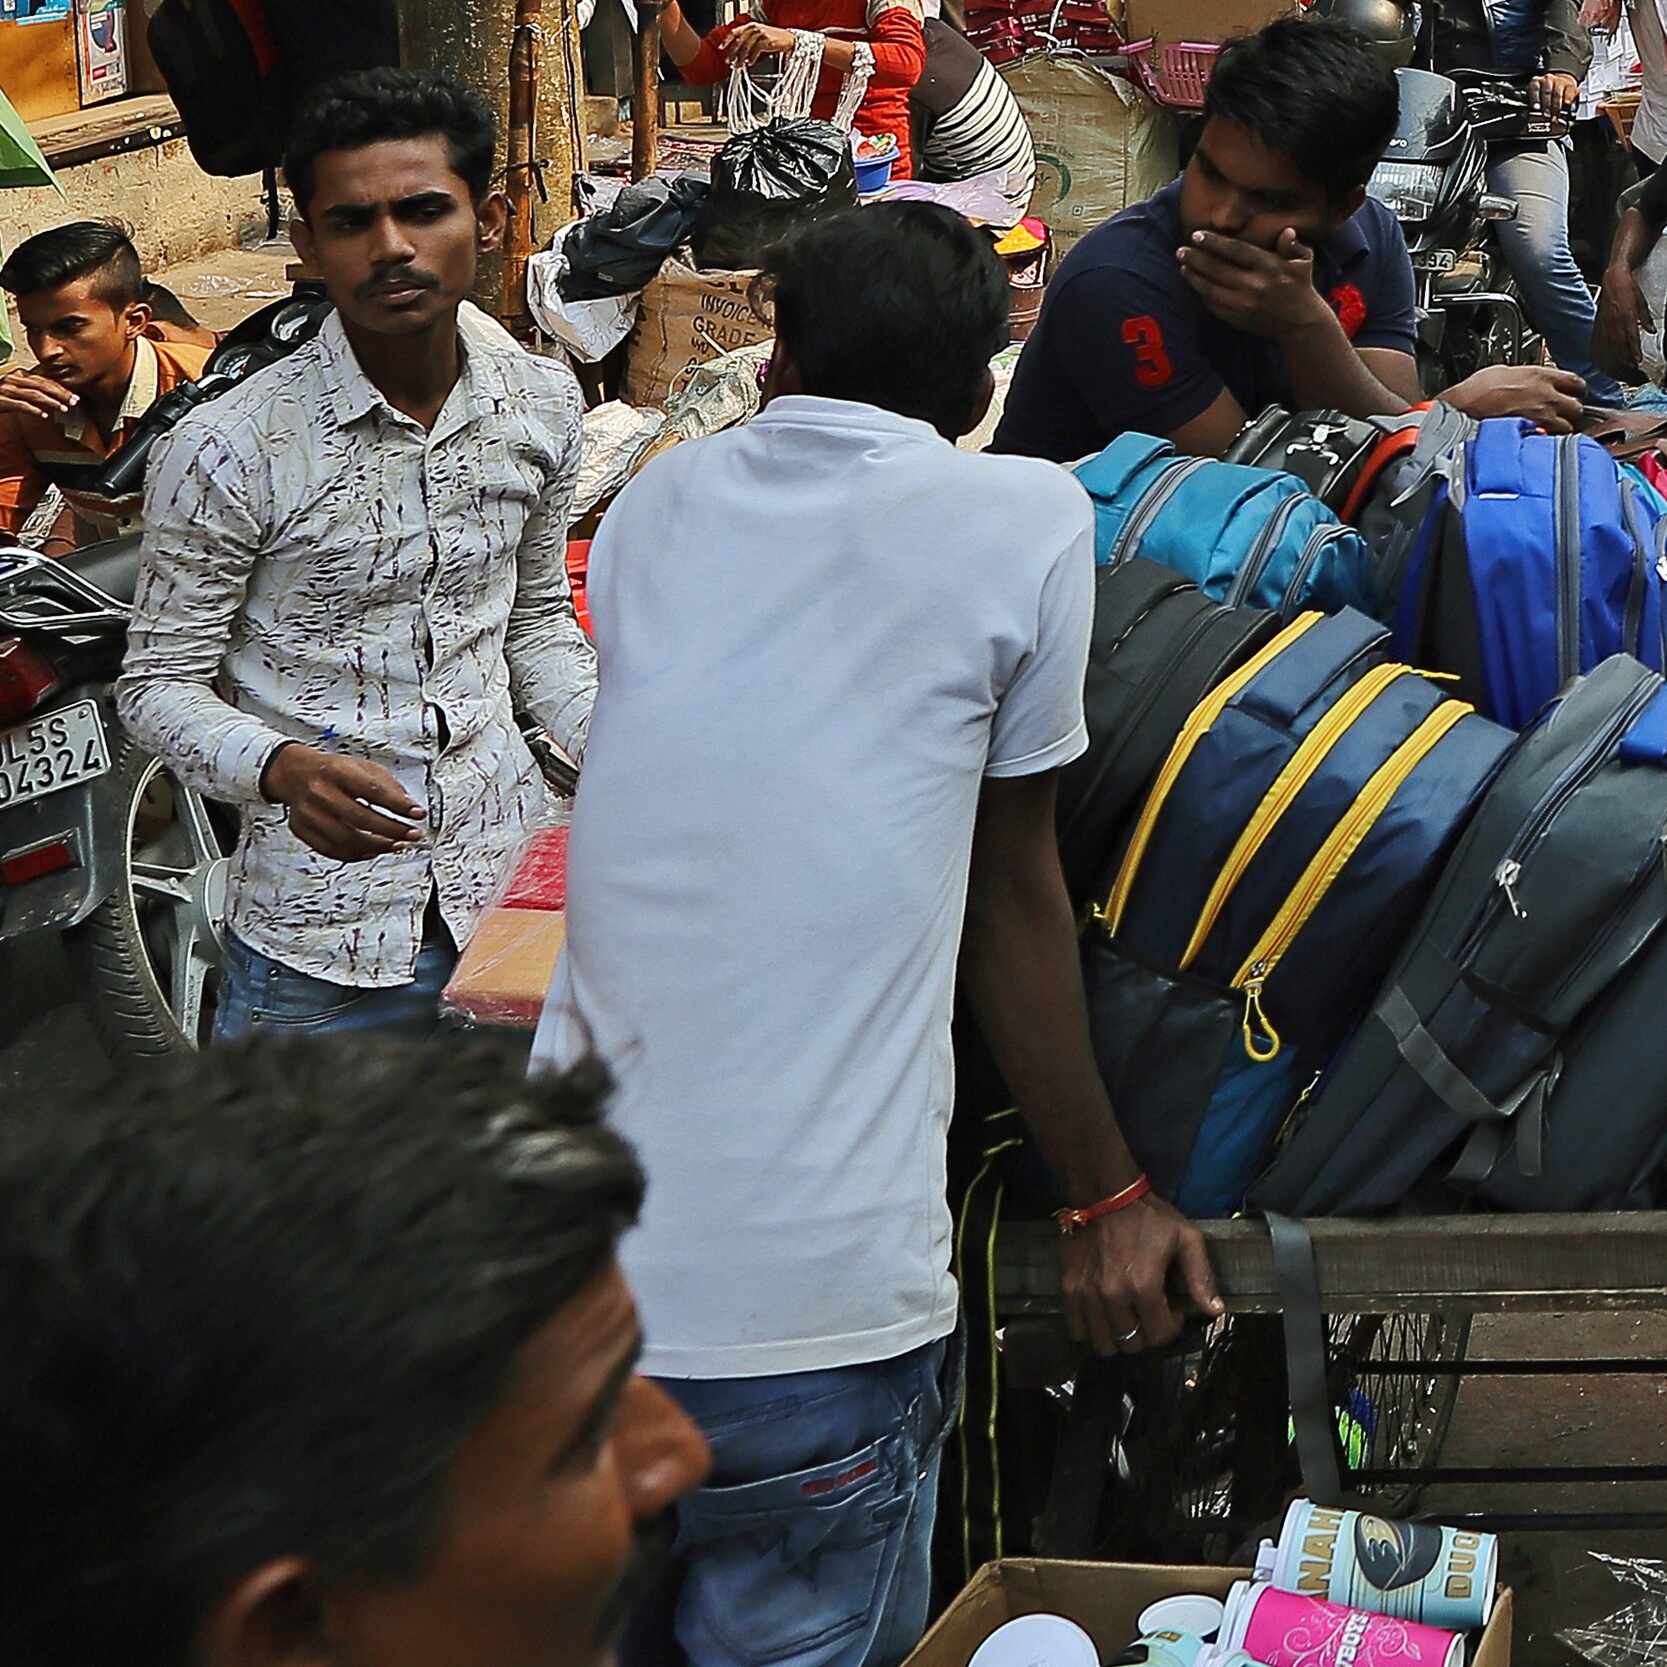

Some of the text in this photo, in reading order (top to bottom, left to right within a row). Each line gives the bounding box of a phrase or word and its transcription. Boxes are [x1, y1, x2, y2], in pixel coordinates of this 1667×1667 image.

[701, 292, 762, 324] INVOICE
[693, 316, 756, 347] GRADE
[1121, 314, 1174, 387] 3
[0, 717, 69, 766] L5S
